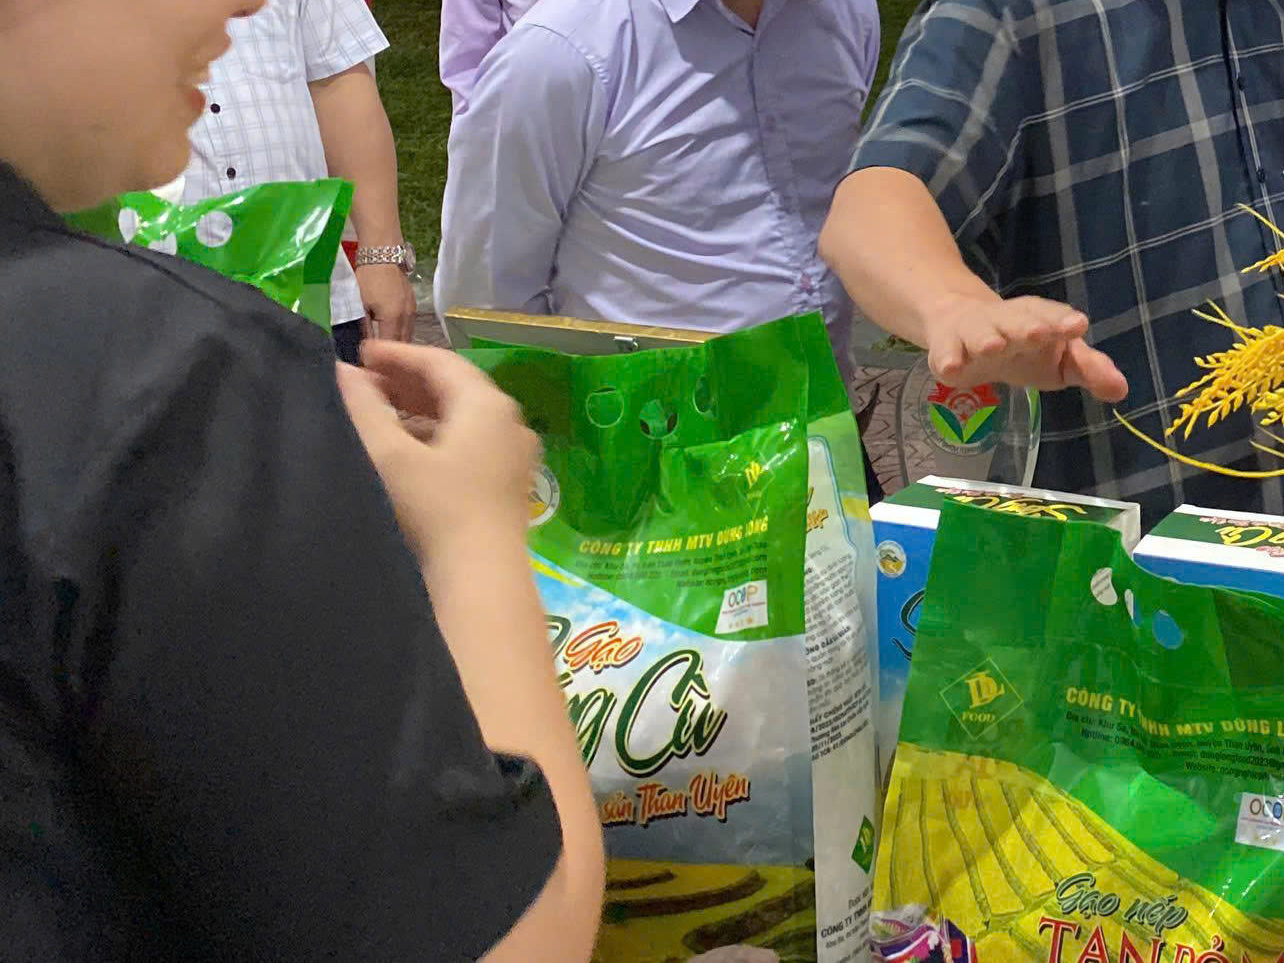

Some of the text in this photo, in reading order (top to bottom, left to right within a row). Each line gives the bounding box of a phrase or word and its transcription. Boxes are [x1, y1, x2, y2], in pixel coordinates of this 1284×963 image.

[686, 533, 714, 551] MTV
[564, 621, 643, 674] Gạo
[615, 649, 728, 778] Cù
[1119, 697, 1137, 719] TY
[636, 783, 688, 827] Than
[690, 772, 751, 823] Uyên
[1056, 872, 1120, 919] Gạo
